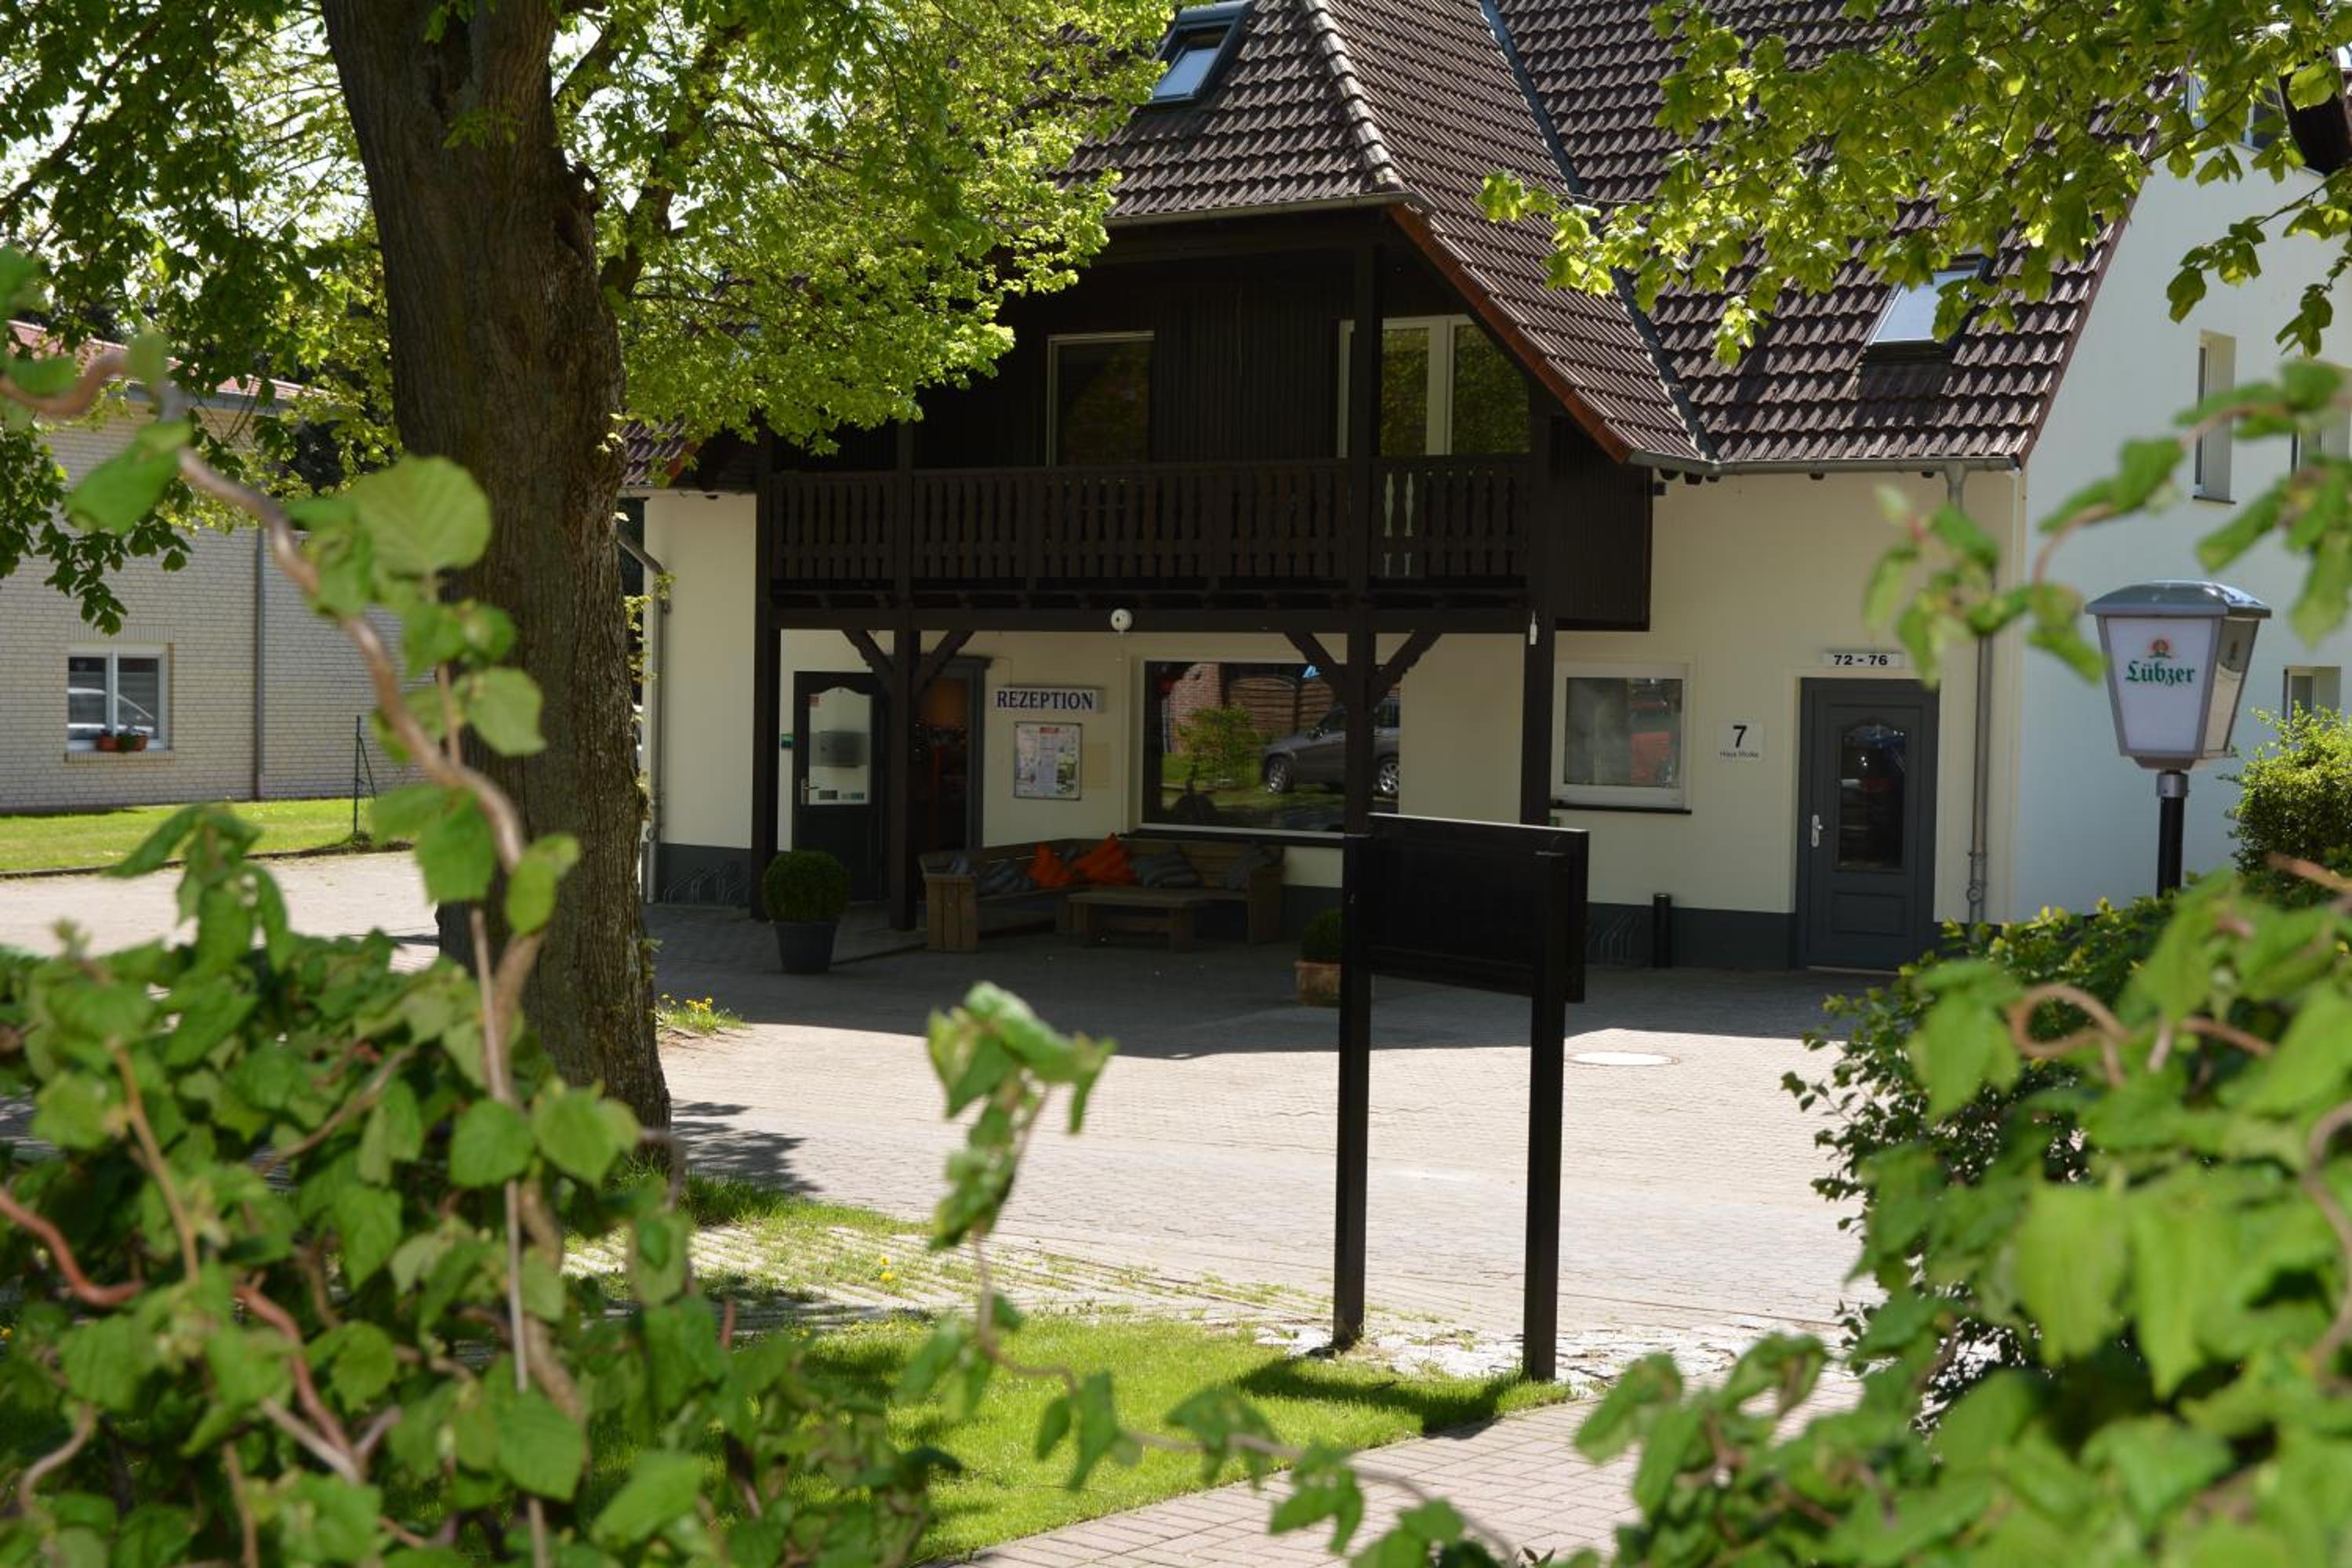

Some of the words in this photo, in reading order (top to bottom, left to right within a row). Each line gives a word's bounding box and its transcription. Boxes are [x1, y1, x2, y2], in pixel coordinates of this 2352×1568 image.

[2125, 660, 2196, 686] Lübzer
[996, 691, 1094, 710] REZEPTION
[1733, 724, 1748, 749] 7
